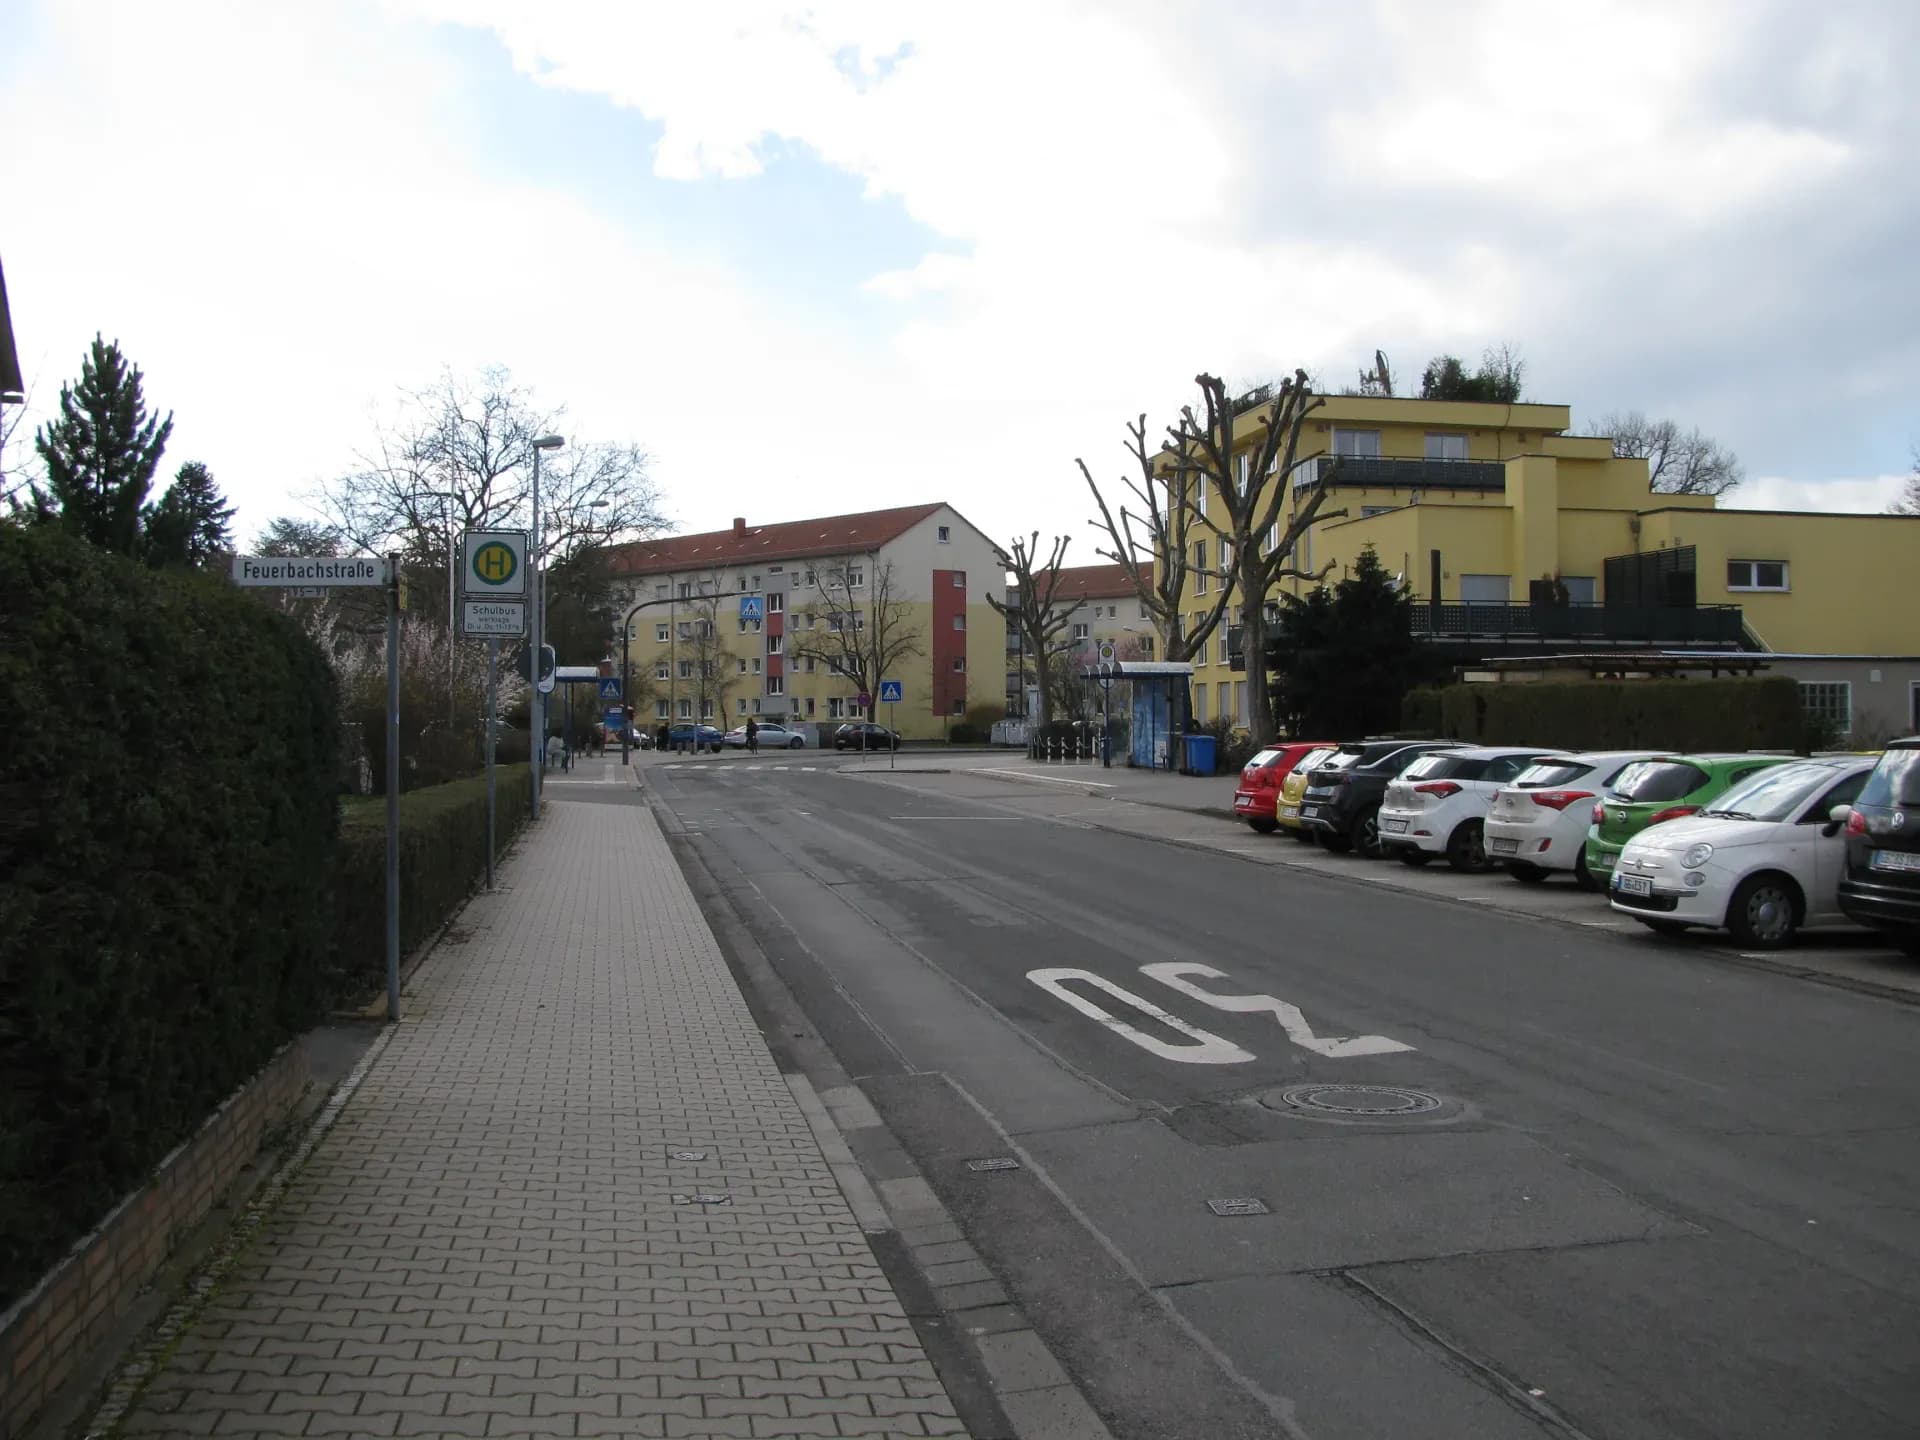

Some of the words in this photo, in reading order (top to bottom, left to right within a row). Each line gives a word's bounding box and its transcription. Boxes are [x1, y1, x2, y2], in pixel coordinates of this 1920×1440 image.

[243, 561, 374, 579] Feuerbachstraße
[486, 551, 505, 576] H
[472, 605, 517, 615] Schulbus
